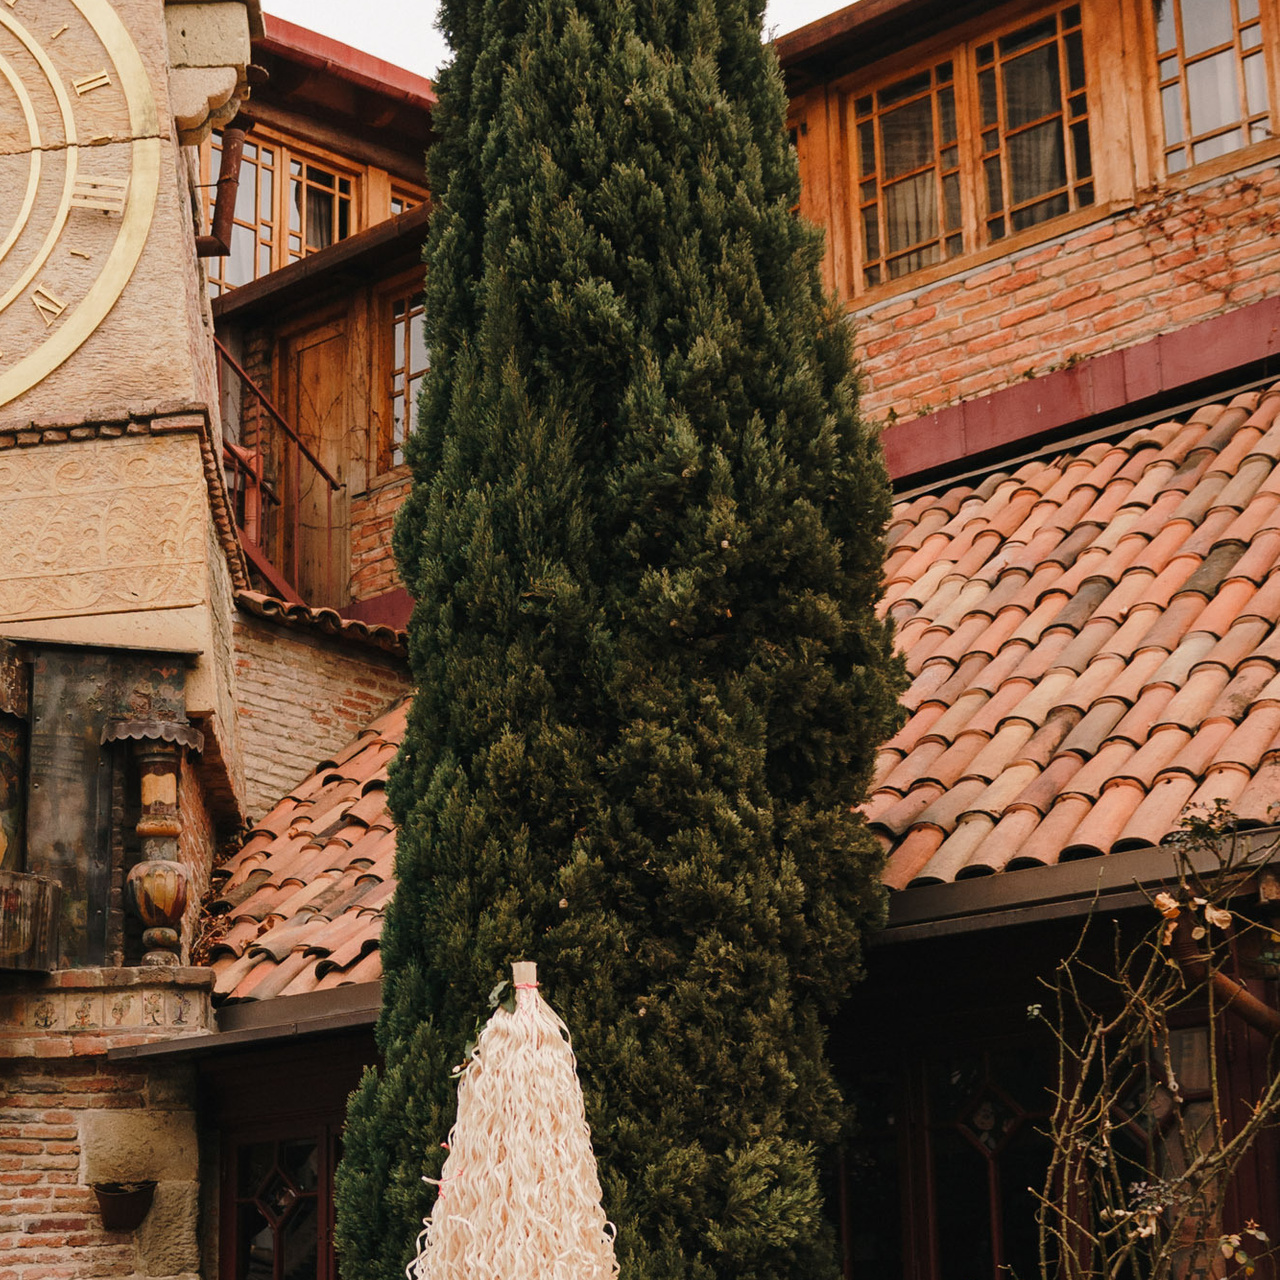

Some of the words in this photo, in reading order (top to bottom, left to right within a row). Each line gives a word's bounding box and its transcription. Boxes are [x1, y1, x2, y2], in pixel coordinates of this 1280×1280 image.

[72, 67, 112, 97] II
[69, 174, 131, 216] III
[30, 282, 70, 328] IV
